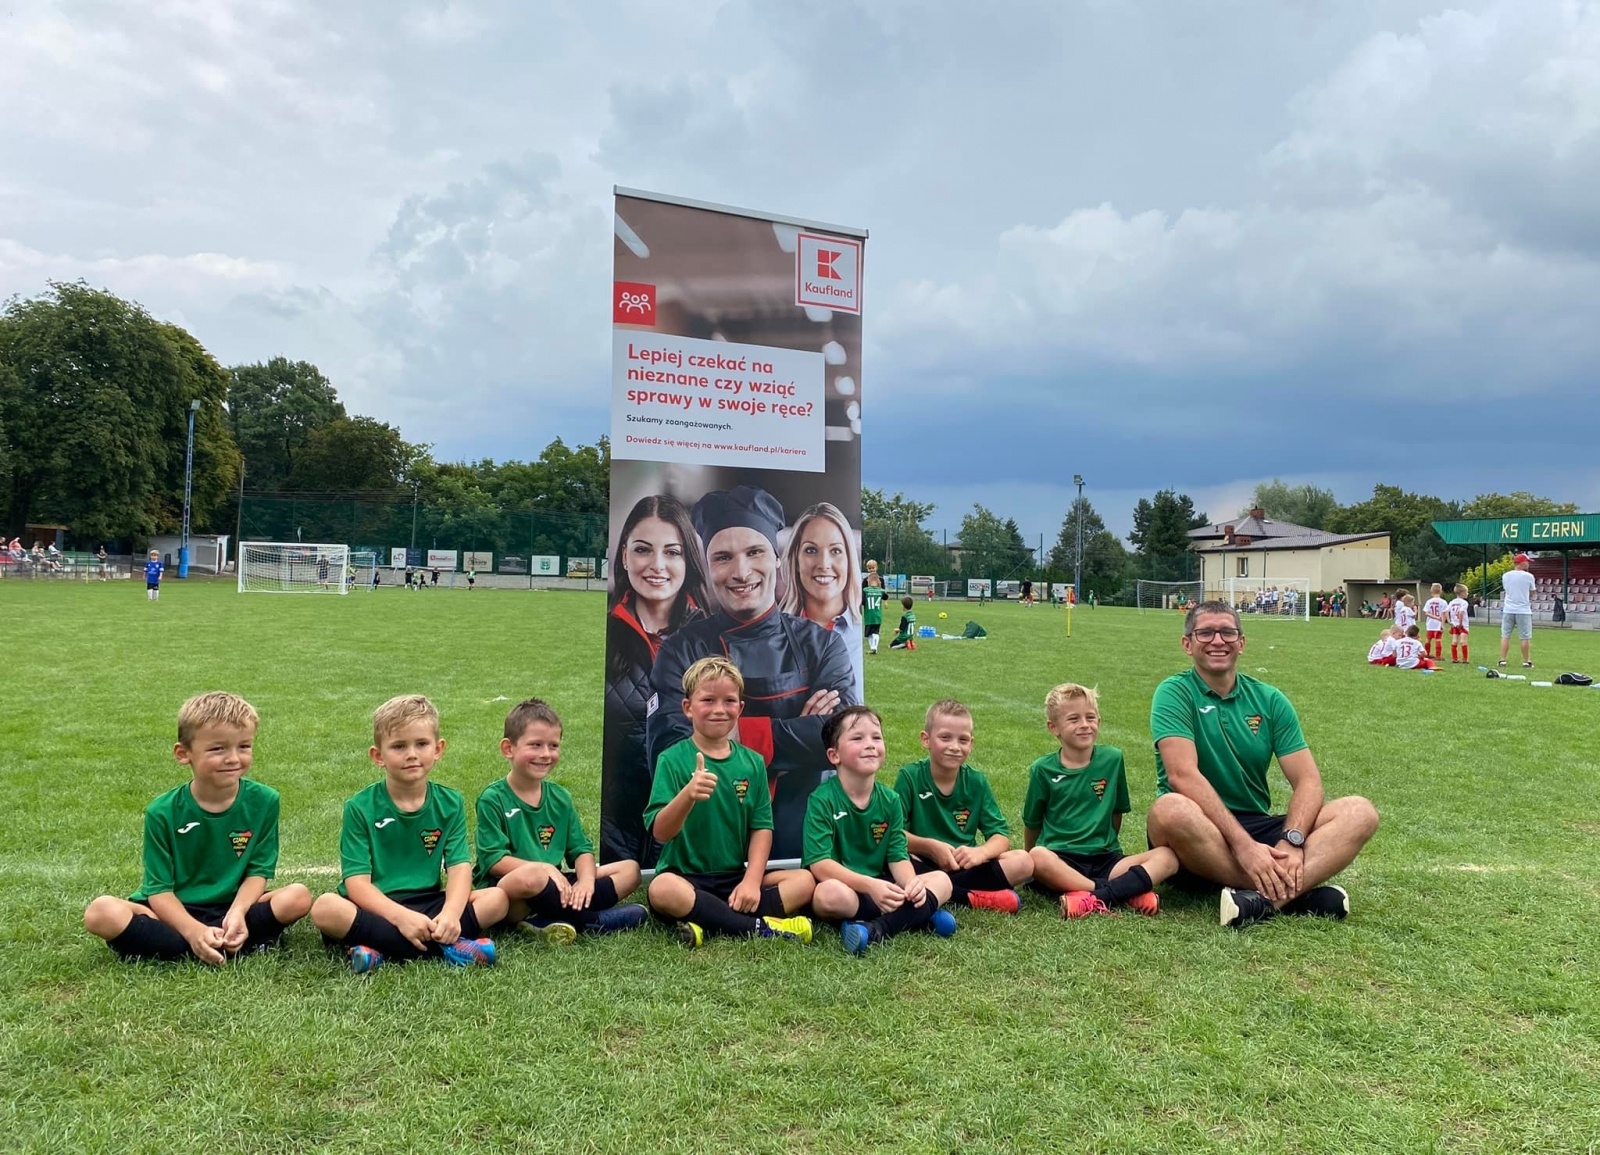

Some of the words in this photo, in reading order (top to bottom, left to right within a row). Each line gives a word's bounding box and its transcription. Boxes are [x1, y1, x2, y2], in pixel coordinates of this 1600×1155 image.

[805, 282, 853, 299] Kaufland
[628, 343, 682, 368] Lepiej
[688, 354, 747, 371] czekać
[752, 362, 773, 374] na
[627, 366, 709, 388] nieznane
[714, 378, 743, 394] czy
[749, 381, 796, 399] wziąć
[627, 389, 693, 410] sprawy
[698, 397, 712, 408] w
[718, 398, 766, 415] swoje
[772, 402, 814, 418] ręce?
[626, 414, 663, 426] Szukamy
[665, 419, 734, 431] zaangażowanych.
[626, 435, 662, 445] Dowiedz
[664, 438, 675, 447] się
[676, 440, 700, 450] więcej
[713, 444, 807, 456] www.kaufland.pl/kariera
[1501, 523, 1519, 538] KS
[1532, 521, 1584, 538] CZARNI
[867, 596, 882, 610] 114
